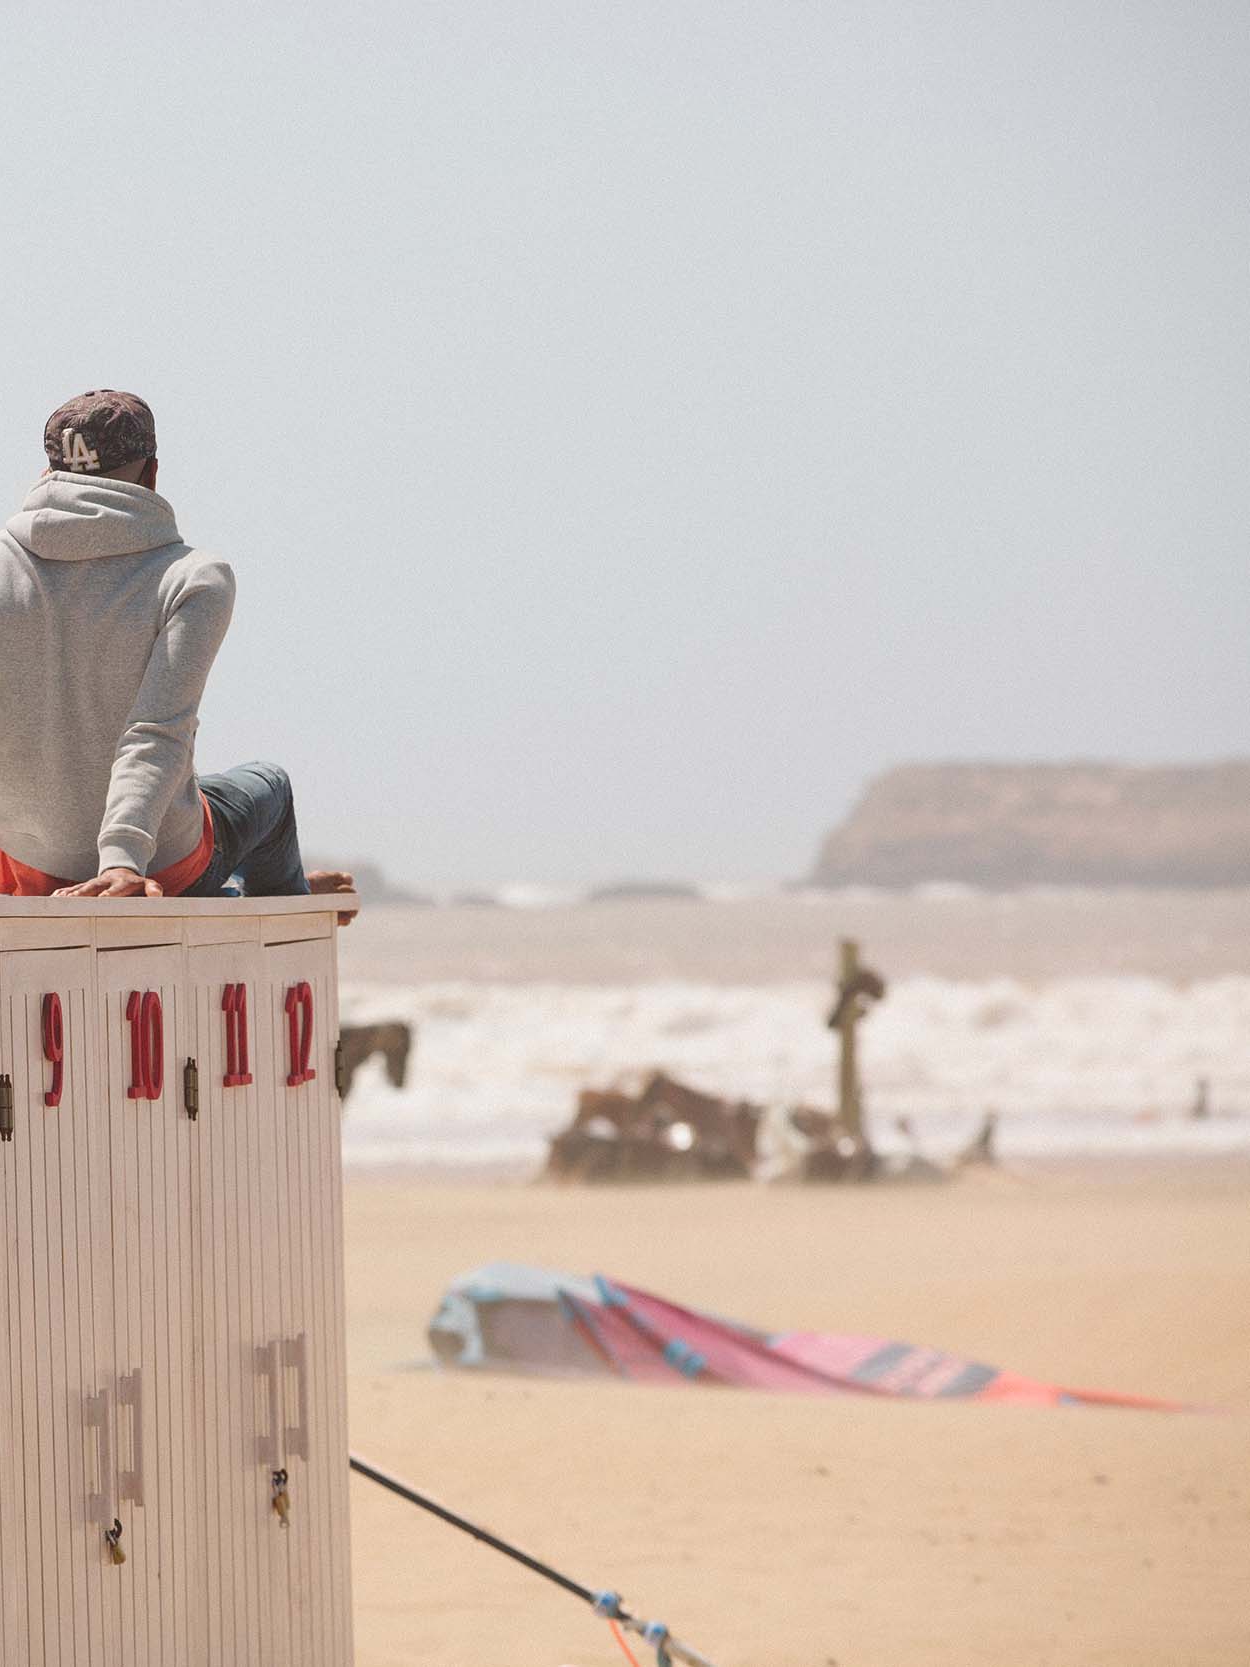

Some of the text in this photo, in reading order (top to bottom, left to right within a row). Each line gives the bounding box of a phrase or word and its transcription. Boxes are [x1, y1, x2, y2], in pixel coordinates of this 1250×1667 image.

[61, 427, 101, 472] LA
[44, 991, 64, 1107] 9
[126, 990, 164, 1100] 10
[221, 983, 254, 1088] 11
[285, 982, 316, 1087] 12
